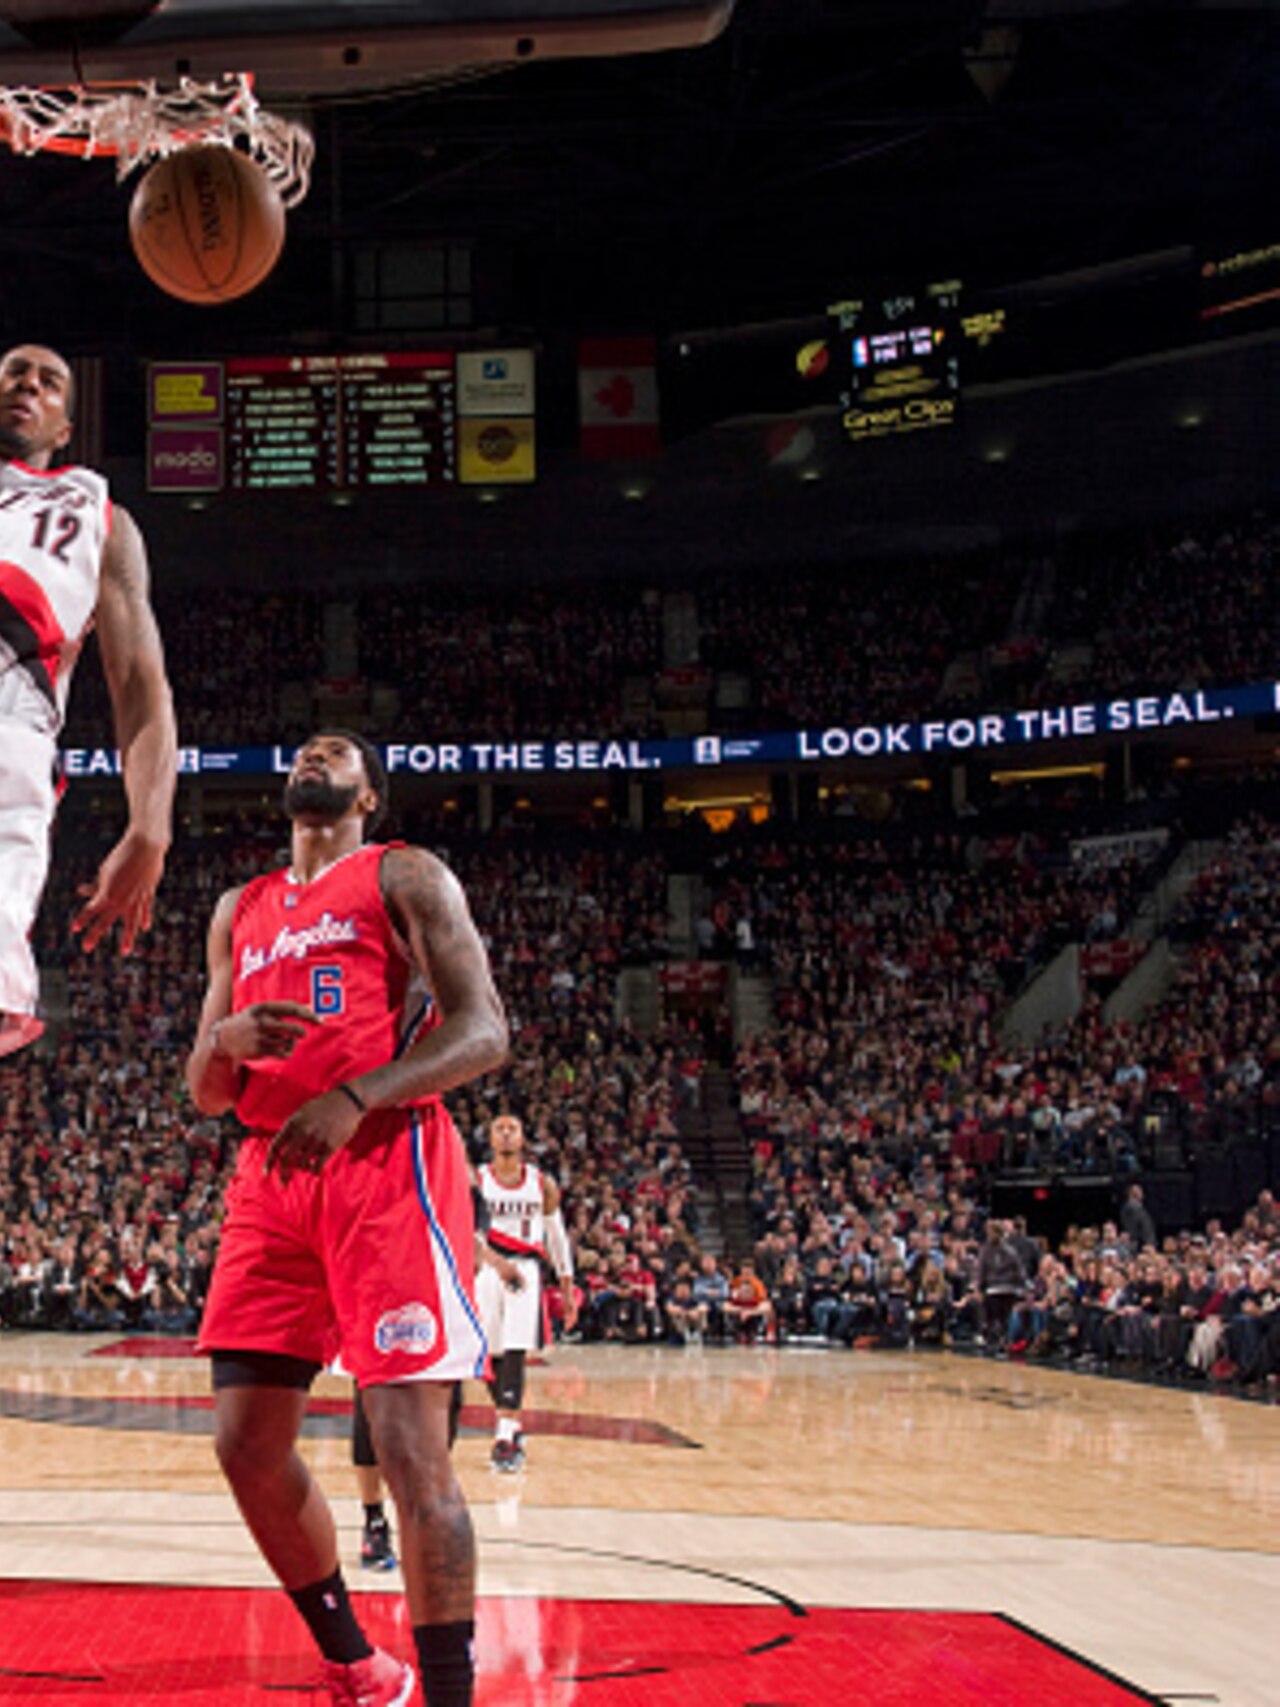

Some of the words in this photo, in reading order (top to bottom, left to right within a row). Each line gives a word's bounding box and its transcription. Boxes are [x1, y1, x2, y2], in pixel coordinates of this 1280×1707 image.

[32, 508, 82, 565] 12
[798, 723, 911, 760] LOOK
[921, 715, 1006, 752] FOR
[1016, 705, 1097, 740] THE
[1106, 691, 1234, 731] SEAL.
[387, 745, 461, 772] FOR
[470, 743, 544, 770] THE
[554, 741, 661, 769] SEAL.
[311, 965, 345, 1015] 6
